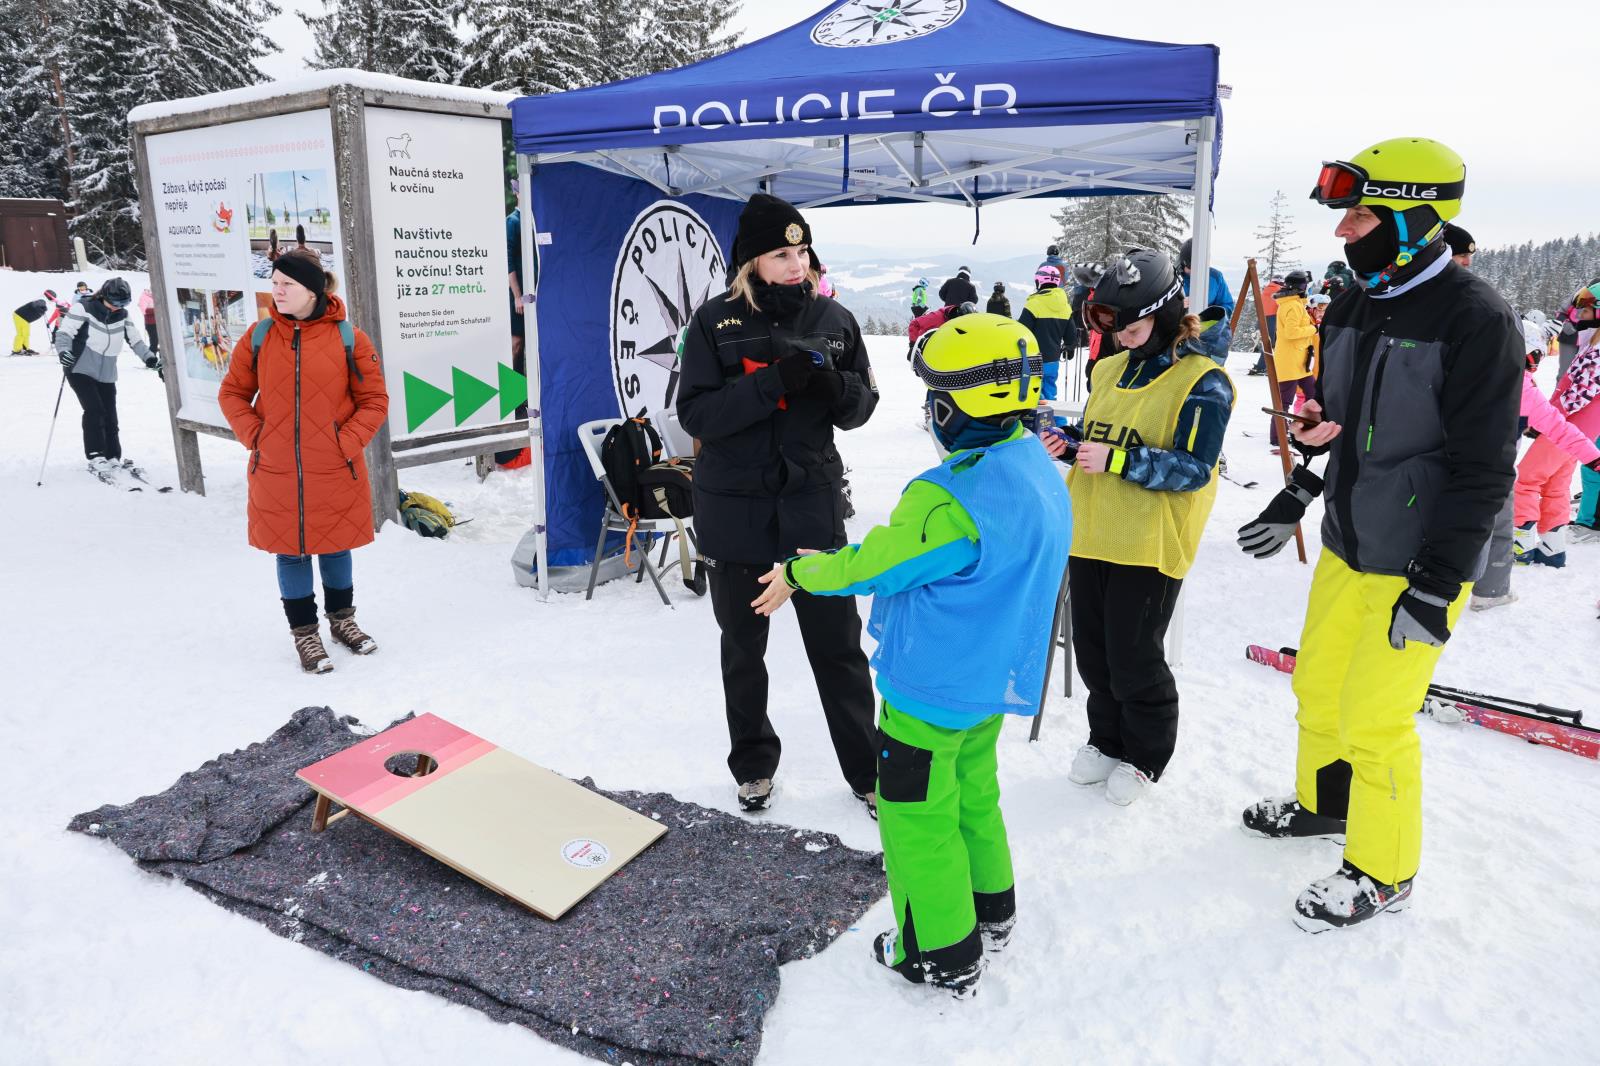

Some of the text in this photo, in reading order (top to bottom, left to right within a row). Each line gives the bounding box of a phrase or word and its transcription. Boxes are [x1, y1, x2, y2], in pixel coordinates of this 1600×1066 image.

[653, 72, 1018, 134] POLICIE ČR
[389, 165, 464, 180] Naučná stezka
[187, 179, 204, 196] když
[204, 177, 227, 195] počasí
[390, 181, 435, 194] k ovčínu
[1362, 181, 1438, 200] bollé
[393, 227, 453, 240] Navštivte
[395, 245, 488, 259] naučnou stezku
[631, 217, 719, 279] POLICIE
[396, 264, 484, 278] k ovčínu! Start
[397, 281, 486, 300] již za 27 metrů.
[399, 310, 431, 319] Besuchen
[431, 309, 442, 317] Sie
[400, 332, 417, 340] Start
[620, 298, 648, 419] ČES
